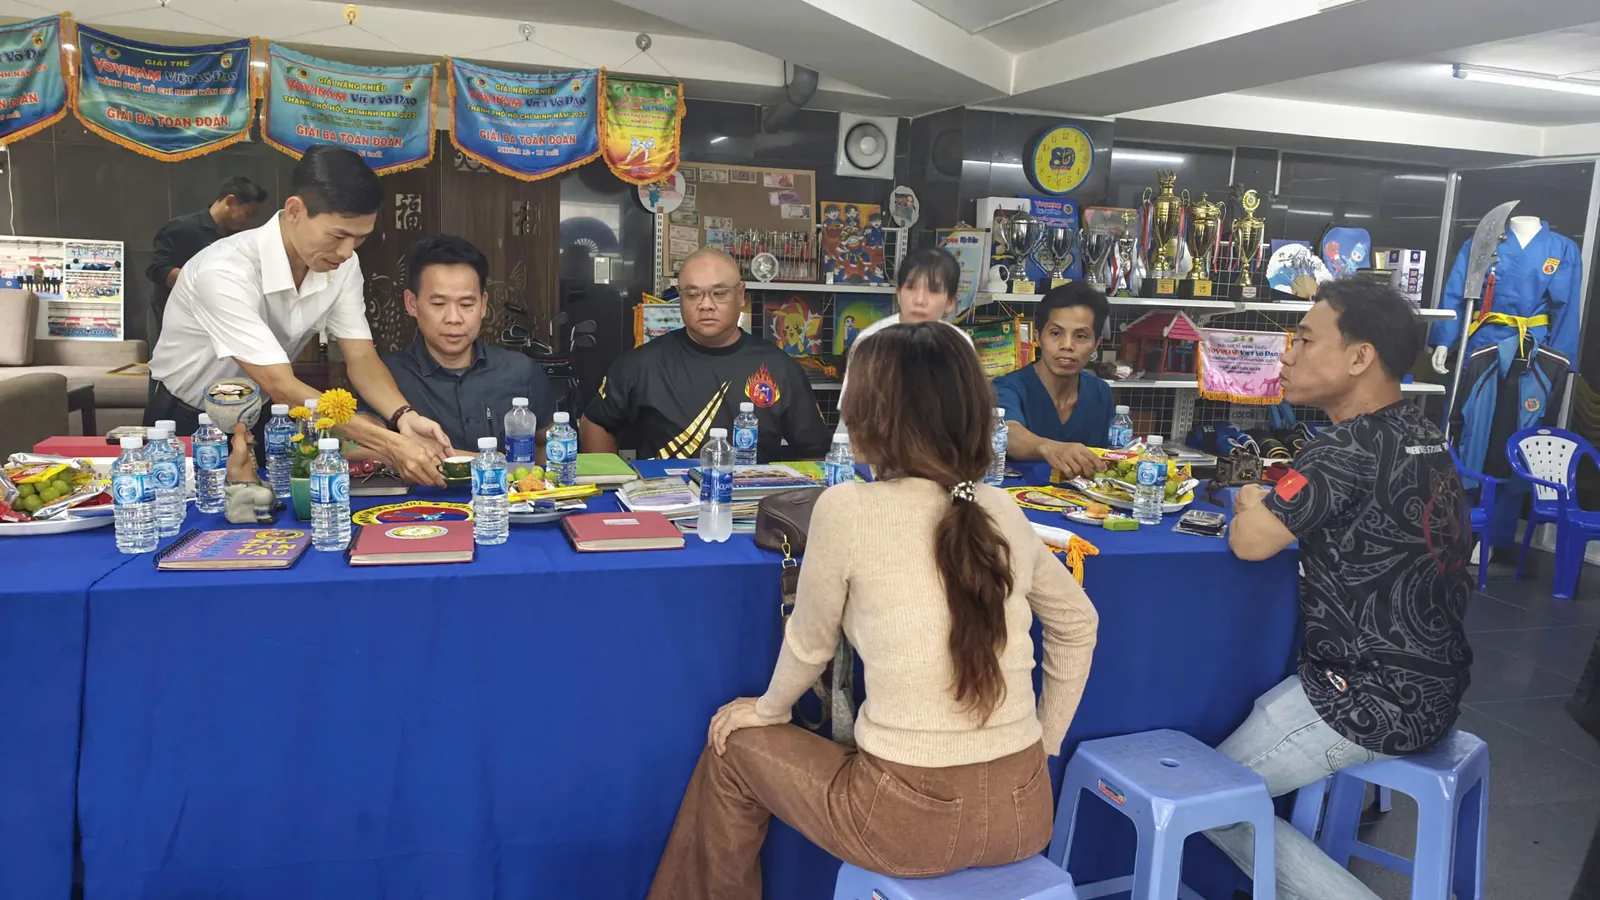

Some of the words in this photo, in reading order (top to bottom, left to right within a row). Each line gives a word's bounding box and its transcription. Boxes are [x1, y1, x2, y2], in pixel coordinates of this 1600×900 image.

[93, 56, 161, 83] VOVINAM
[164, 70, 195, 86] VIỆT
[95, 75, 122, 88] THÀNH
[123, 81, 140, 92] PHỐ
[143, 84, 156, 94] HỒ
[157, 86, 173, 95] CHÍ
[175, 88, 198, 96] MINH
[199, 88, 217, 96] NĂM
[285, 77, 347, 103] VOVINAM
[351, 94, 376, 107] VIỆT
[378, 94, 393, 106] VÕ
[394, 94, 417, 109] ĐẠO
[318, 76, 335, 87] GIẢI
[337, 79, 360, 91] NĂNG
[361, 80, 387, 93] KHIẾU
[495, 83, 511, 94] GIẢI
[512, 84, 533, 95] NĂNG
[283, 94, 310, 109] THÀNH
[329, 103, 341, 113] HỒ
[343, 106, 357, 115] CHÍ
[358, 108, 378, 117] MINH
[380, 109, 398, 118] NĂM
[466, 86, 523, 109] VOVINAM
[106, 106, 132, 121] GIẢI
[135, 113, 153, 125] BA
[157, 114, 192, 128] TOÀN
[195, 114, 229, 128] ĐOÀN
[491, 107, 506, 118] PHỐ
[519, 112, 533, 120] CHÍ
[296, 123, 319, 138] GIẢI
[322, 129, 337, 141] BA
[339, 131, 370, 146] TOÀN
[372, 133, 403, 148] ĐOÀN
[479, 127, 500, 142] GIẢI
[503, 133, 517, 145] BA
[519, 132, 546, 146] TOÀN
[548, 131, 577, 146] ĐOÀN
